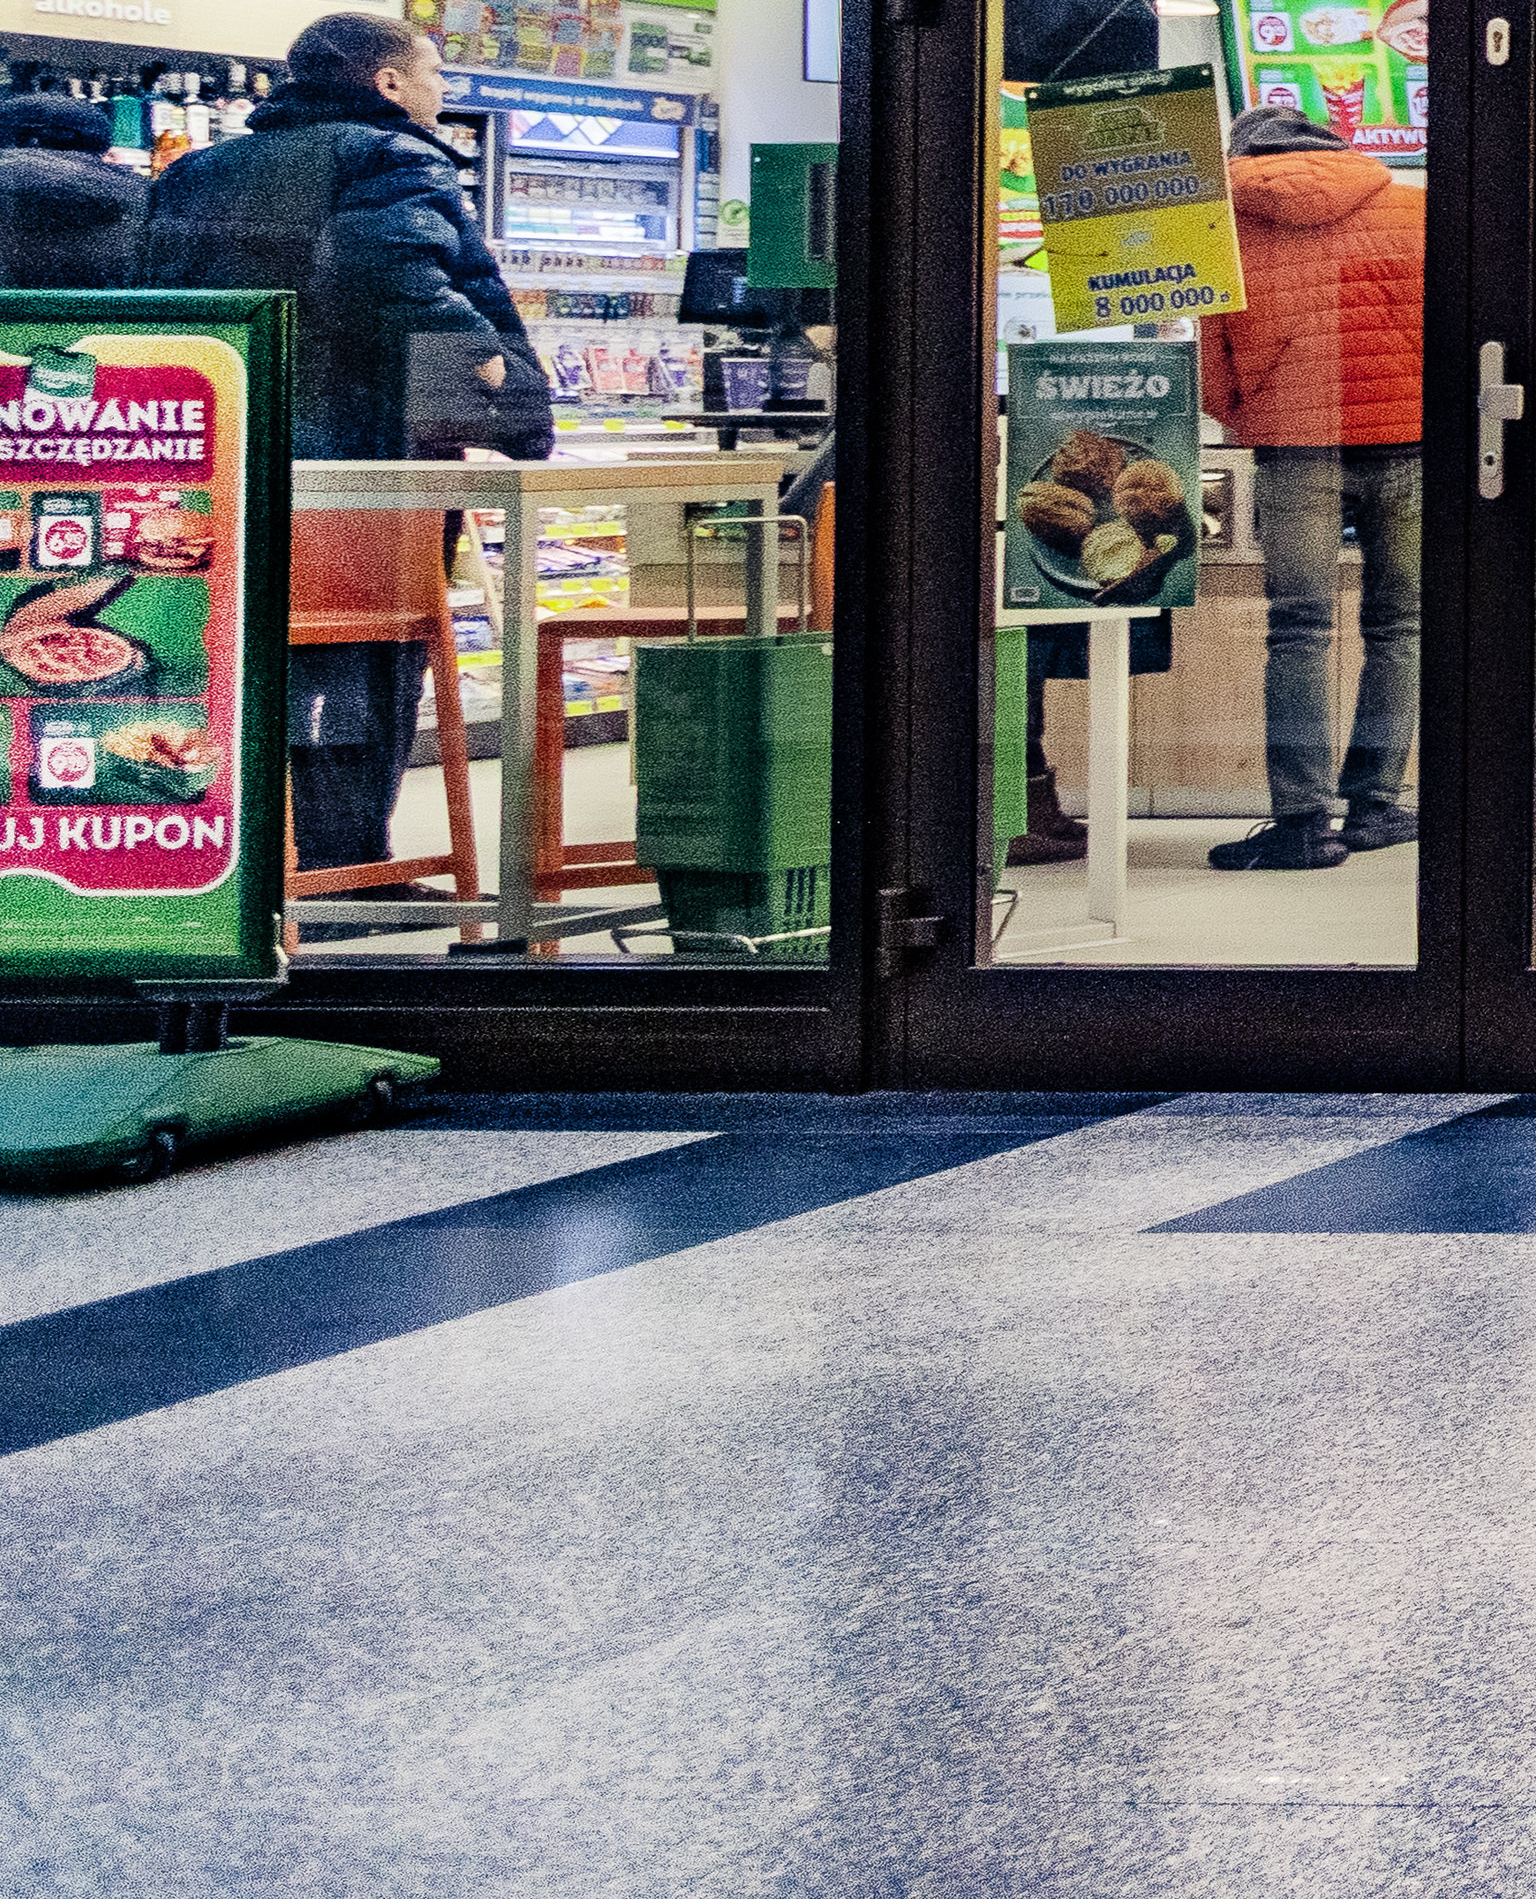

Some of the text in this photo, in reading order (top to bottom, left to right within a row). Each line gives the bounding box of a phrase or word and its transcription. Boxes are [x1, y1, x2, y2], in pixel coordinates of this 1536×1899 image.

[1062, 151, 1192, 182] DO WYGRANIA
[1087, 262, 1197, 292] KUMULACJA
[1096, 296, 1111, 318] 8
[1120, 291, 1165, 316] 000
[1170, 285, 1215, 308] 000
[1035, 370, 1171, 400] ŚWIEŻO
[58, 815, 226, 850] KUPON
